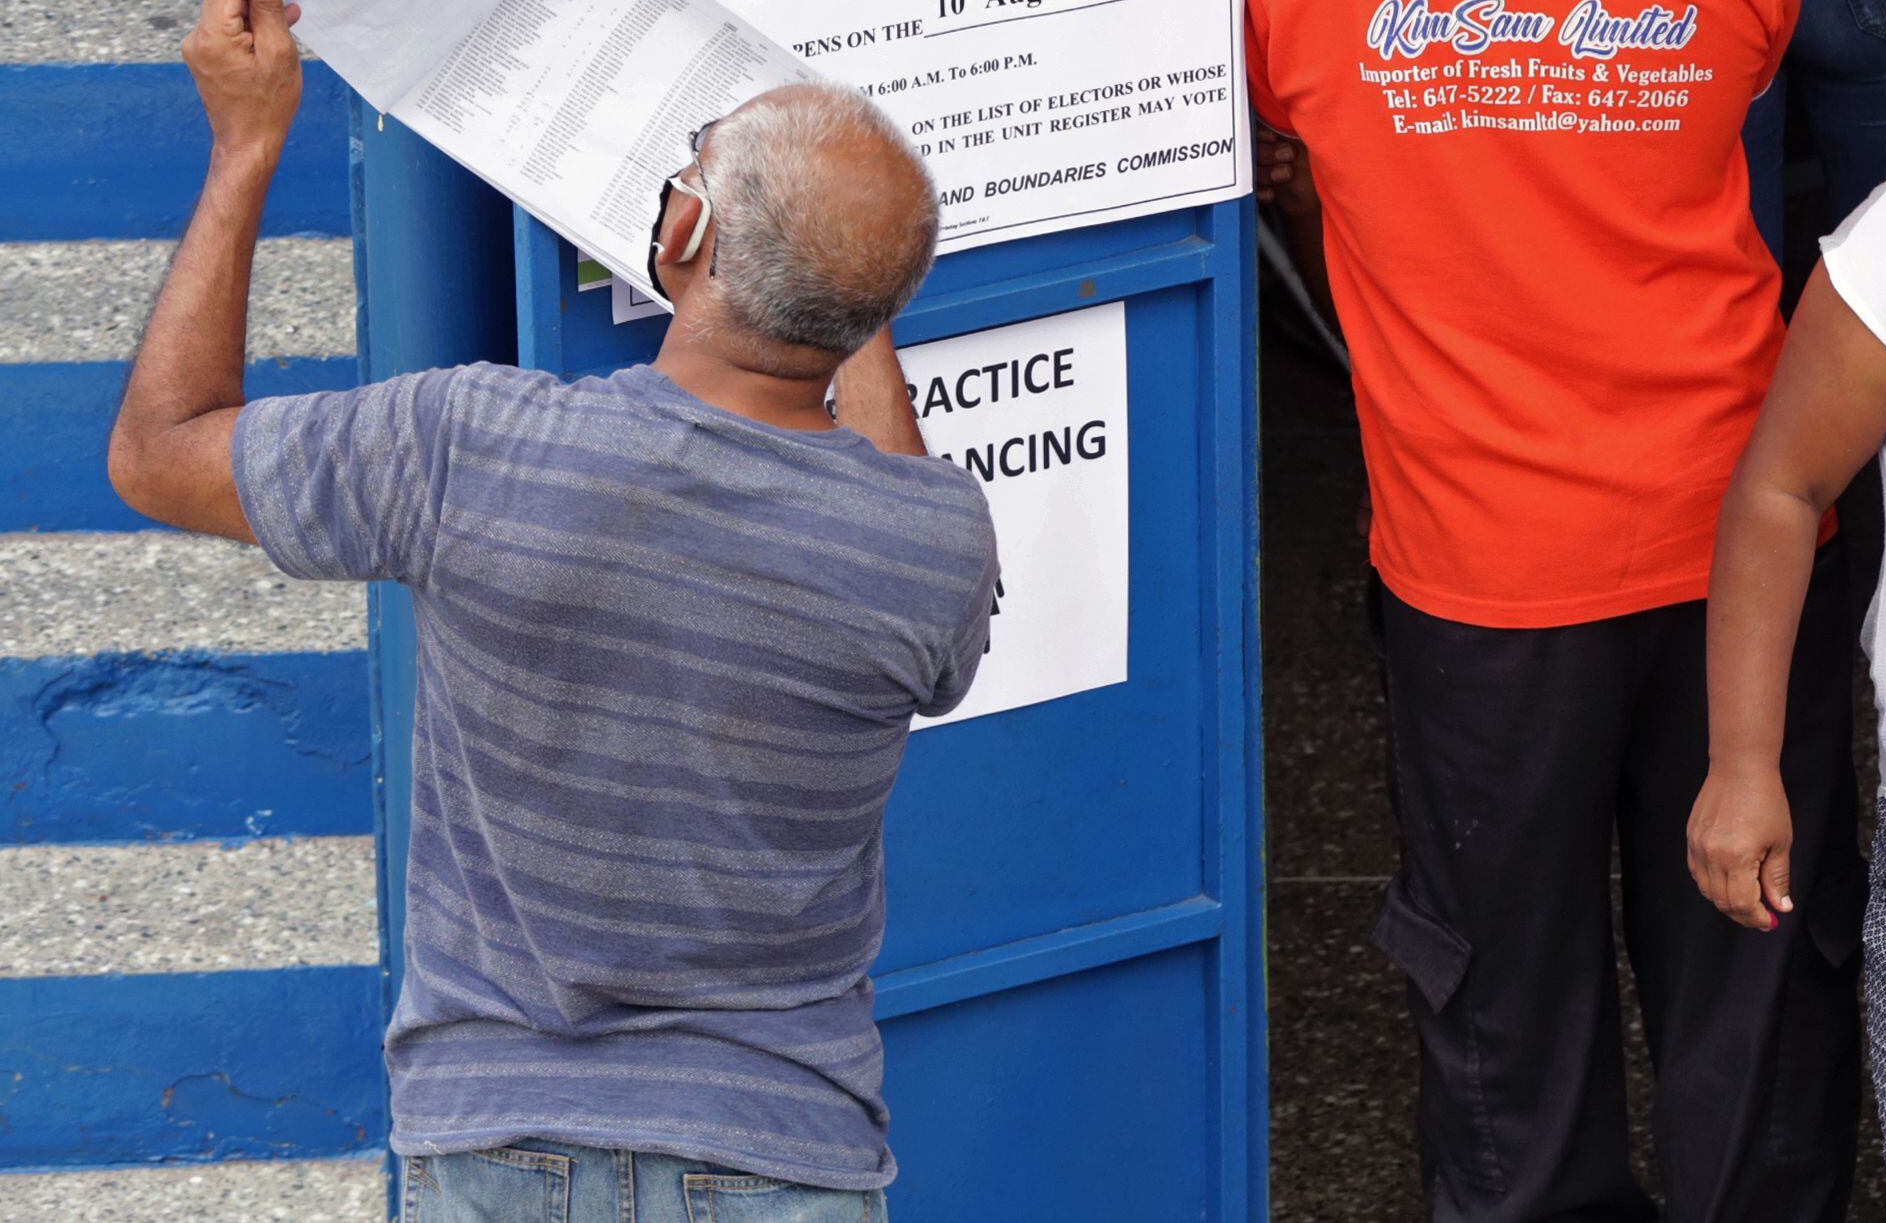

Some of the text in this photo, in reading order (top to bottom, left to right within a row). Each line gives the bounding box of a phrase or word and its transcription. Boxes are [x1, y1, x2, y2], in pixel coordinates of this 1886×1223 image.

[847, 29, 875, 48] ON
[882, 19, 923, 41] THE
[878, 78, 907, 96] 6:00
[911, 71, 944, 89] A.M.
[948, 67, 966, 81] To
[970, 58, 999, 77] 6:00
[1004, 53, 1037, 70] P.M.
[1360, 58, 1713, 87] Importer of Fresh Fruits & Vegetables
[912, 64, 1227, 136] ON THE LIST OF ELECTORS OR WHOSE
[1383, 89, 1417, 108] Tel:
[1423, 85, 1521, 107] 647-5222
[1542, 84, 1581, 105] Fax:
[1588, 89, 1689, 108] 647-2066
[938, 138, 955, 154] IN
[962, 130, 995, 148] THE
[1002, 122, 1043, 140] UNIT
[1050, 105, 1132, 133] REGISTER
[1138, 96, 1176, 115] MAY
[1182, 87, 1228, 107] VOTE
[1393, 110, 1681, 135] E-mail: kimsamltd@yahoo.com
[939, 137, 1234, 206] AND BOUNDARIES COMMISSION
